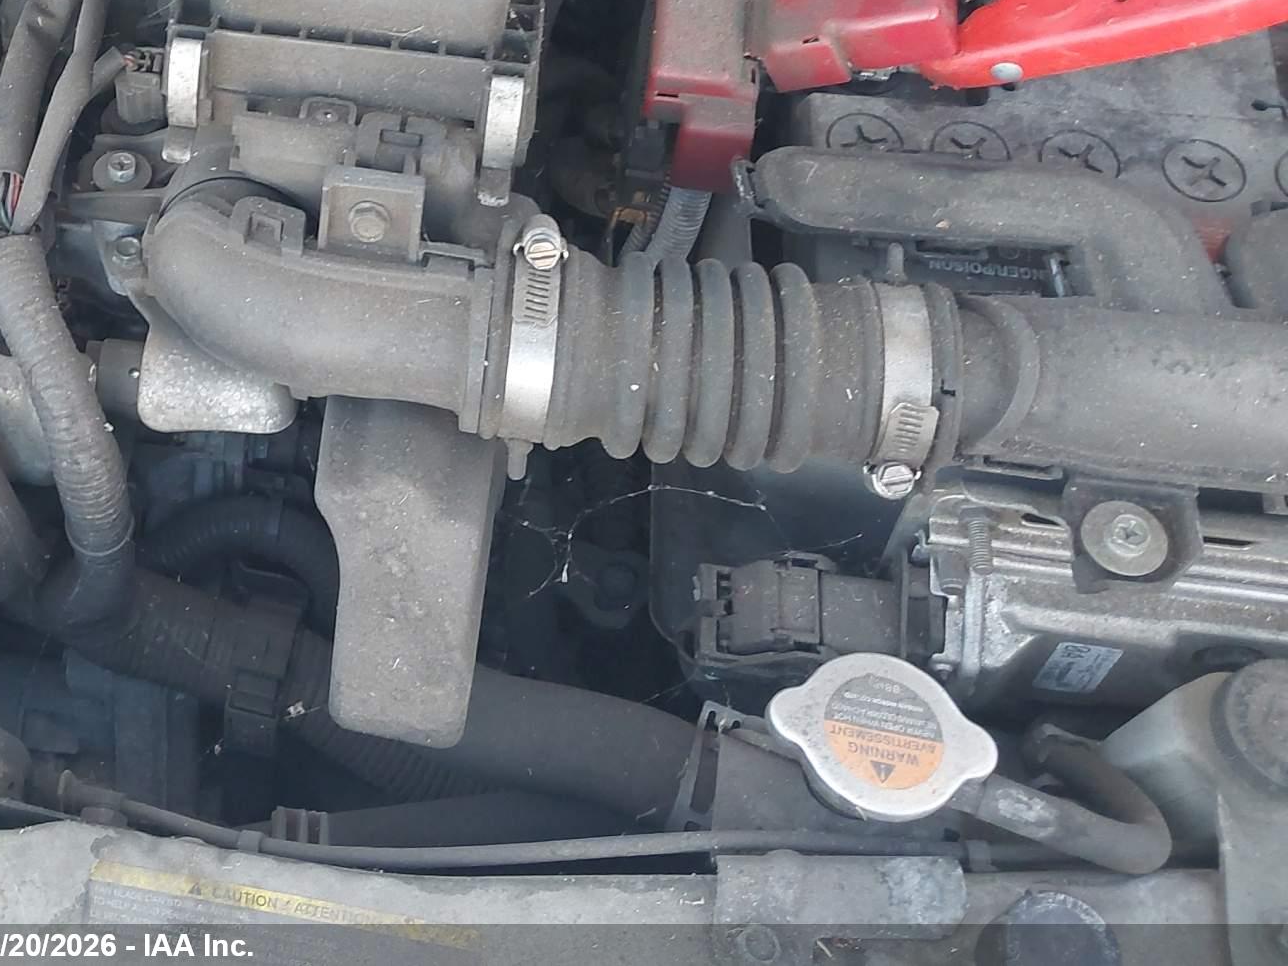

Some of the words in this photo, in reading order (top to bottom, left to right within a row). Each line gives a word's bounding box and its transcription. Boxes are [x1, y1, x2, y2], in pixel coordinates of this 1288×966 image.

[829, 724, 937, 753] AVERTISSEMENT
[847, 741, 920, 766] WARNING
[212, 887, 278, 909] CAUTION
